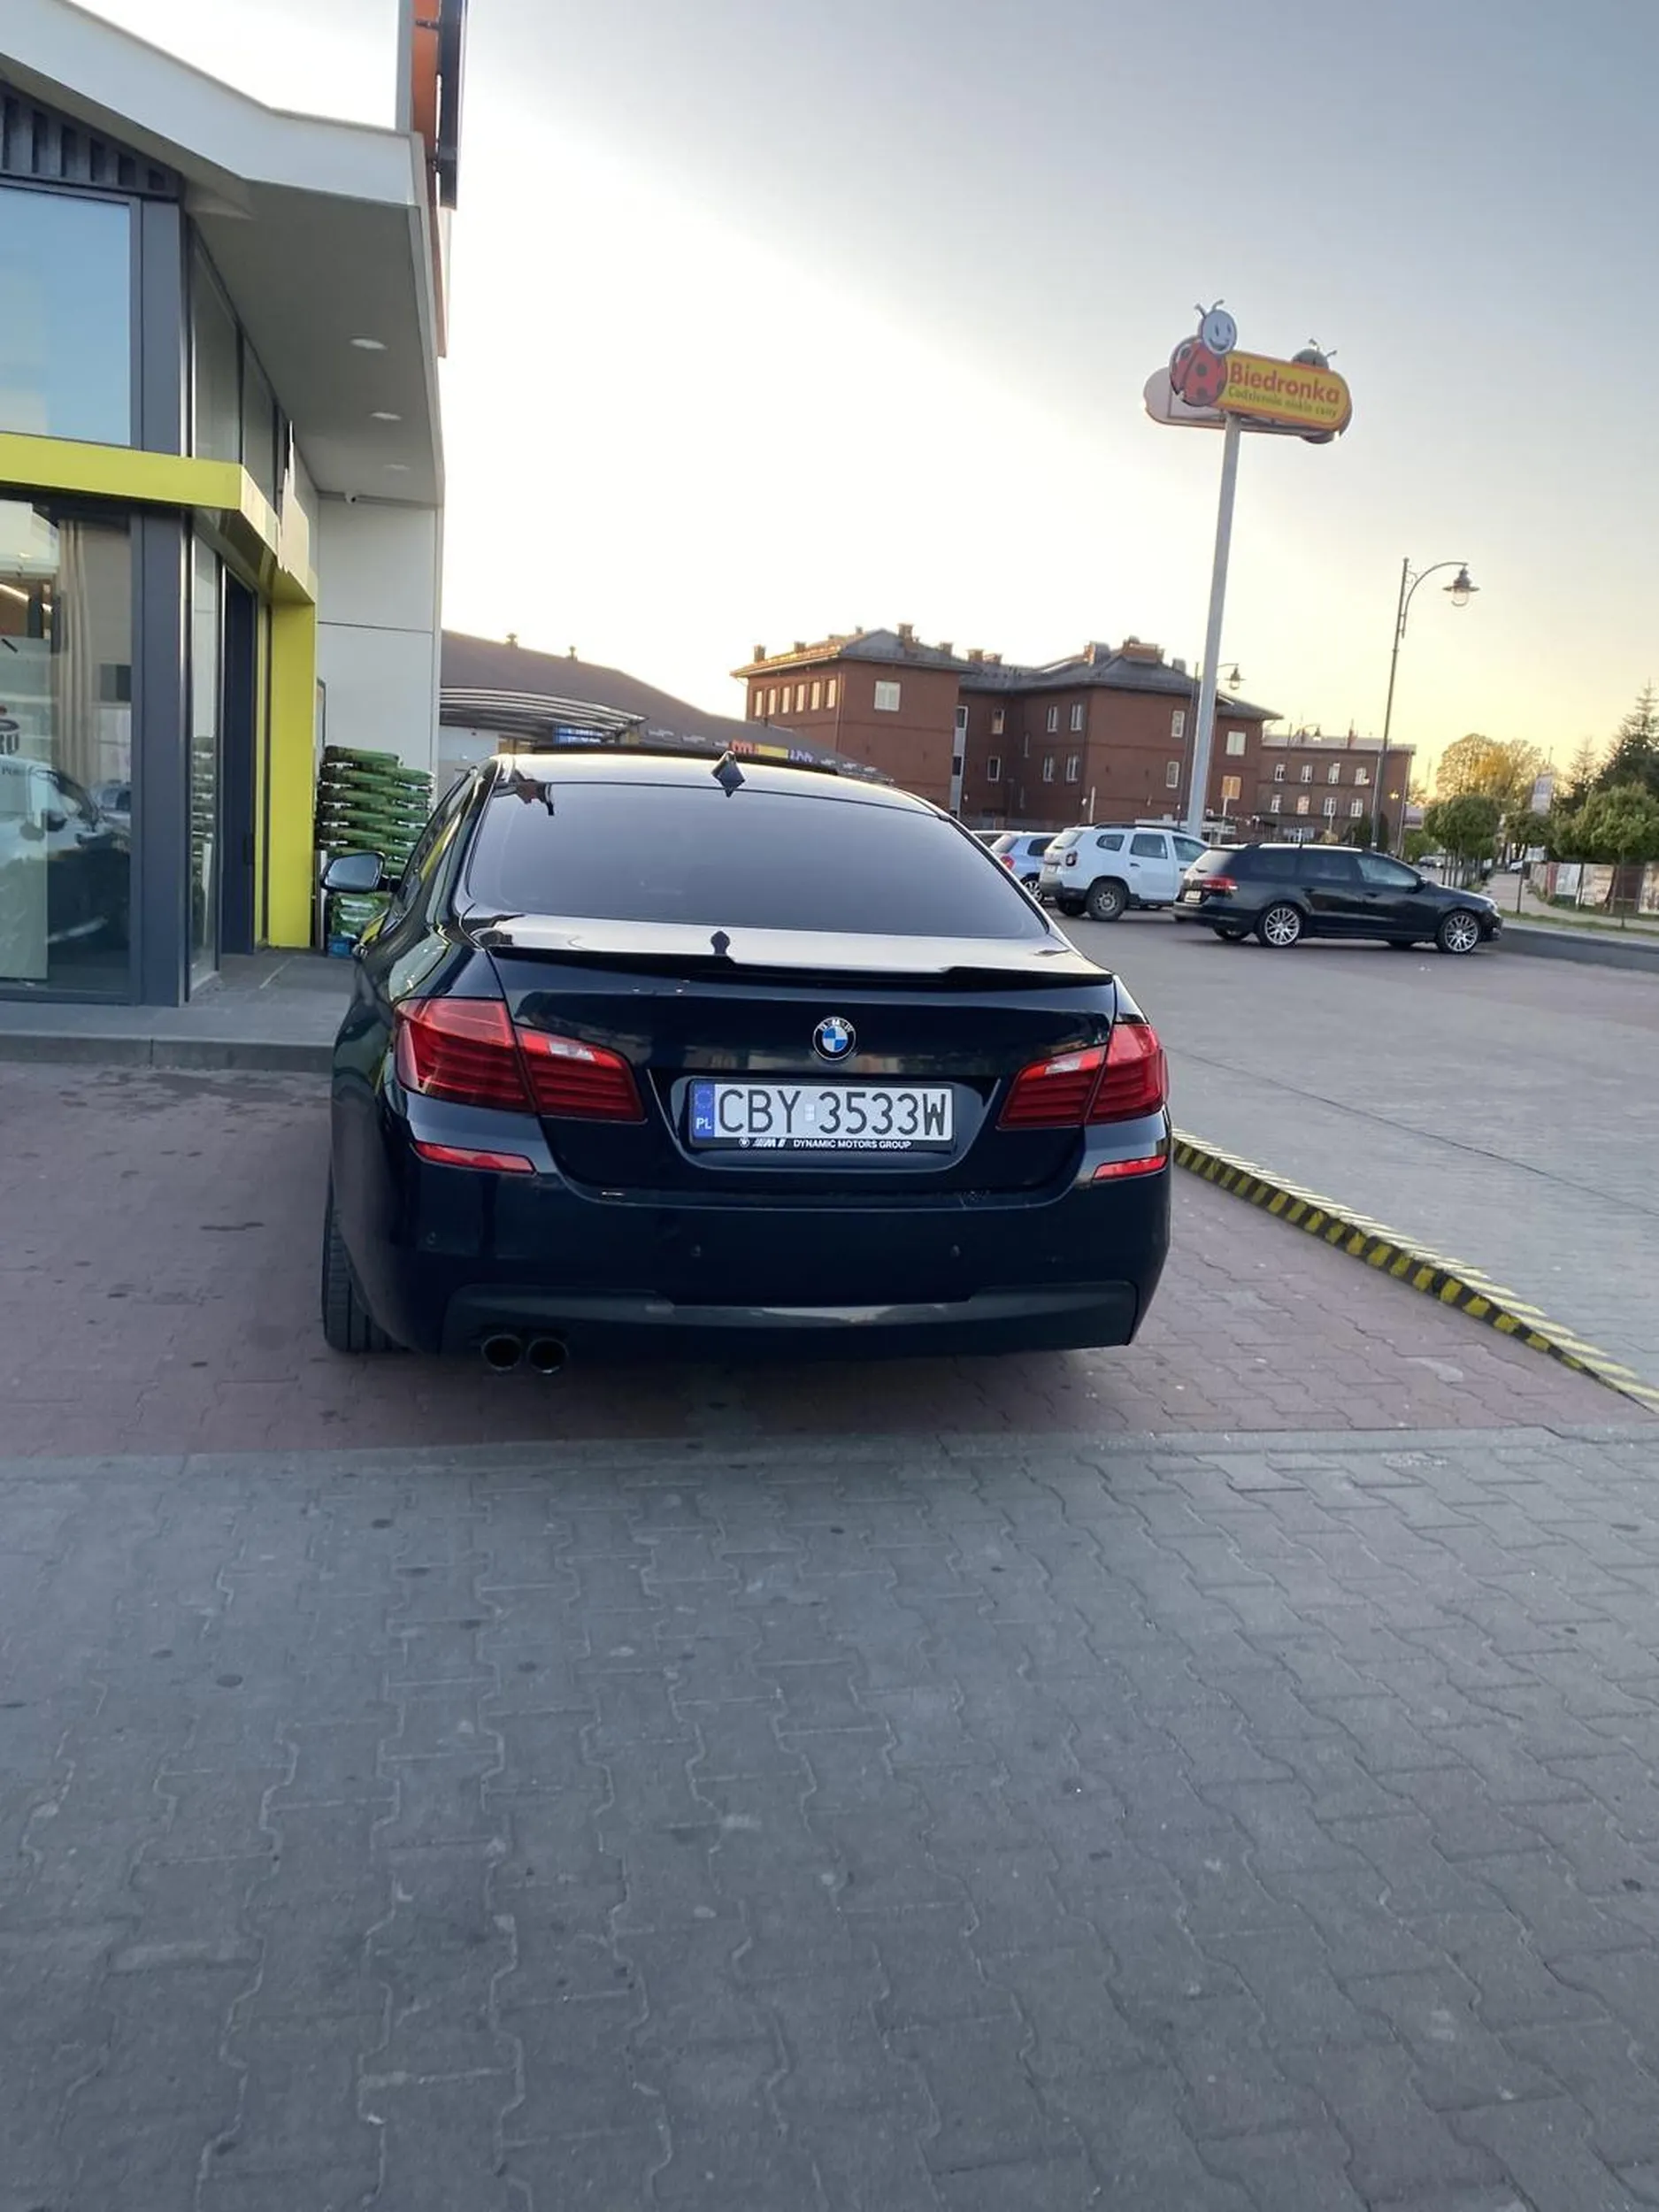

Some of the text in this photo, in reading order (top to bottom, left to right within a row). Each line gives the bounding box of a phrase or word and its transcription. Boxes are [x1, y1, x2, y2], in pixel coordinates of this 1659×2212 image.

[1230, 361, 1340, 403] Biedronka
[696, 1118, 711, 1131] PL
[718, 1088, 947, 1137] CBY 3533W
[793, 1139, 836, 1149] DYNAMIC
[837, 1140, 878, 1149] MOTORS
[879, 1141, 912, 1149] GROUP
